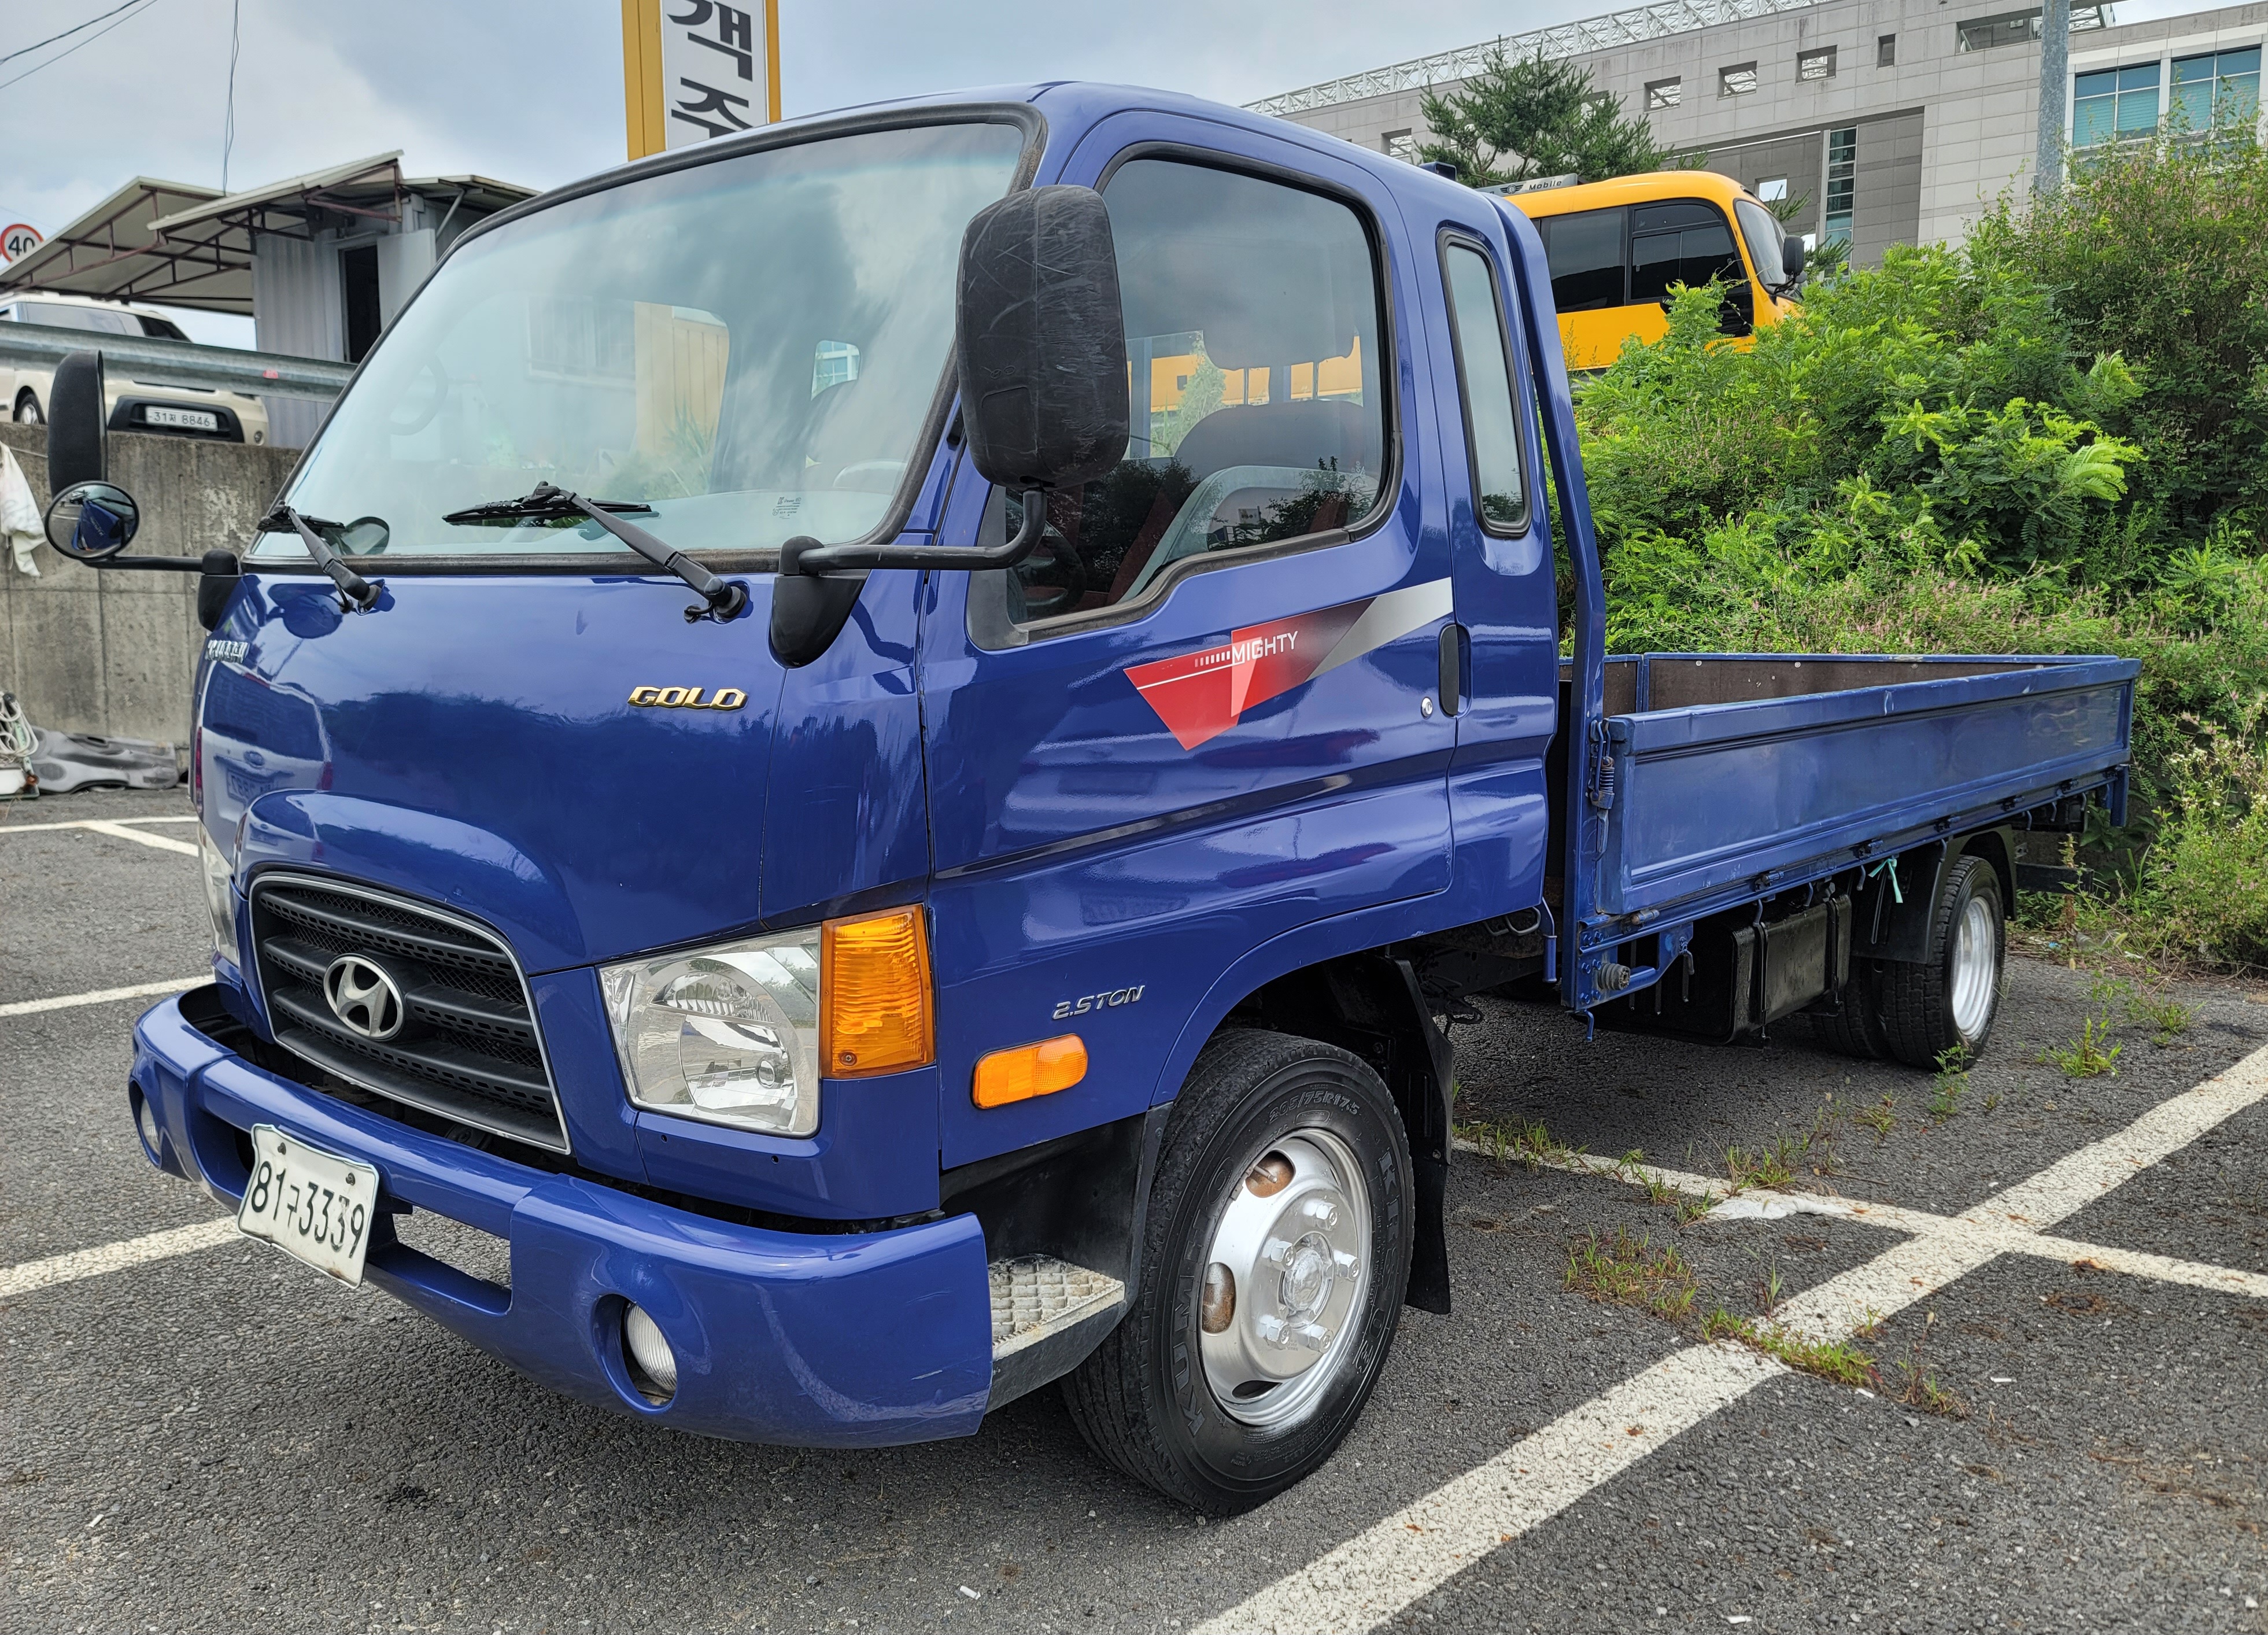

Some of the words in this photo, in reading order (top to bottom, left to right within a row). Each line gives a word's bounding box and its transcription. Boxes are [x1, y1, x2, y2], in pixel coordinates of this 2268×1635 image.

[1528, 180, 1563, 191] Mobile
[8, 235, 35, 256] 40
[182, 415, 210, 427] 8846
[1232, 630, 1298, 665] MIGHTY
[627, 686, 748, 711] GOLD
[1172, 1157, 1233, 1437] KUMHO
